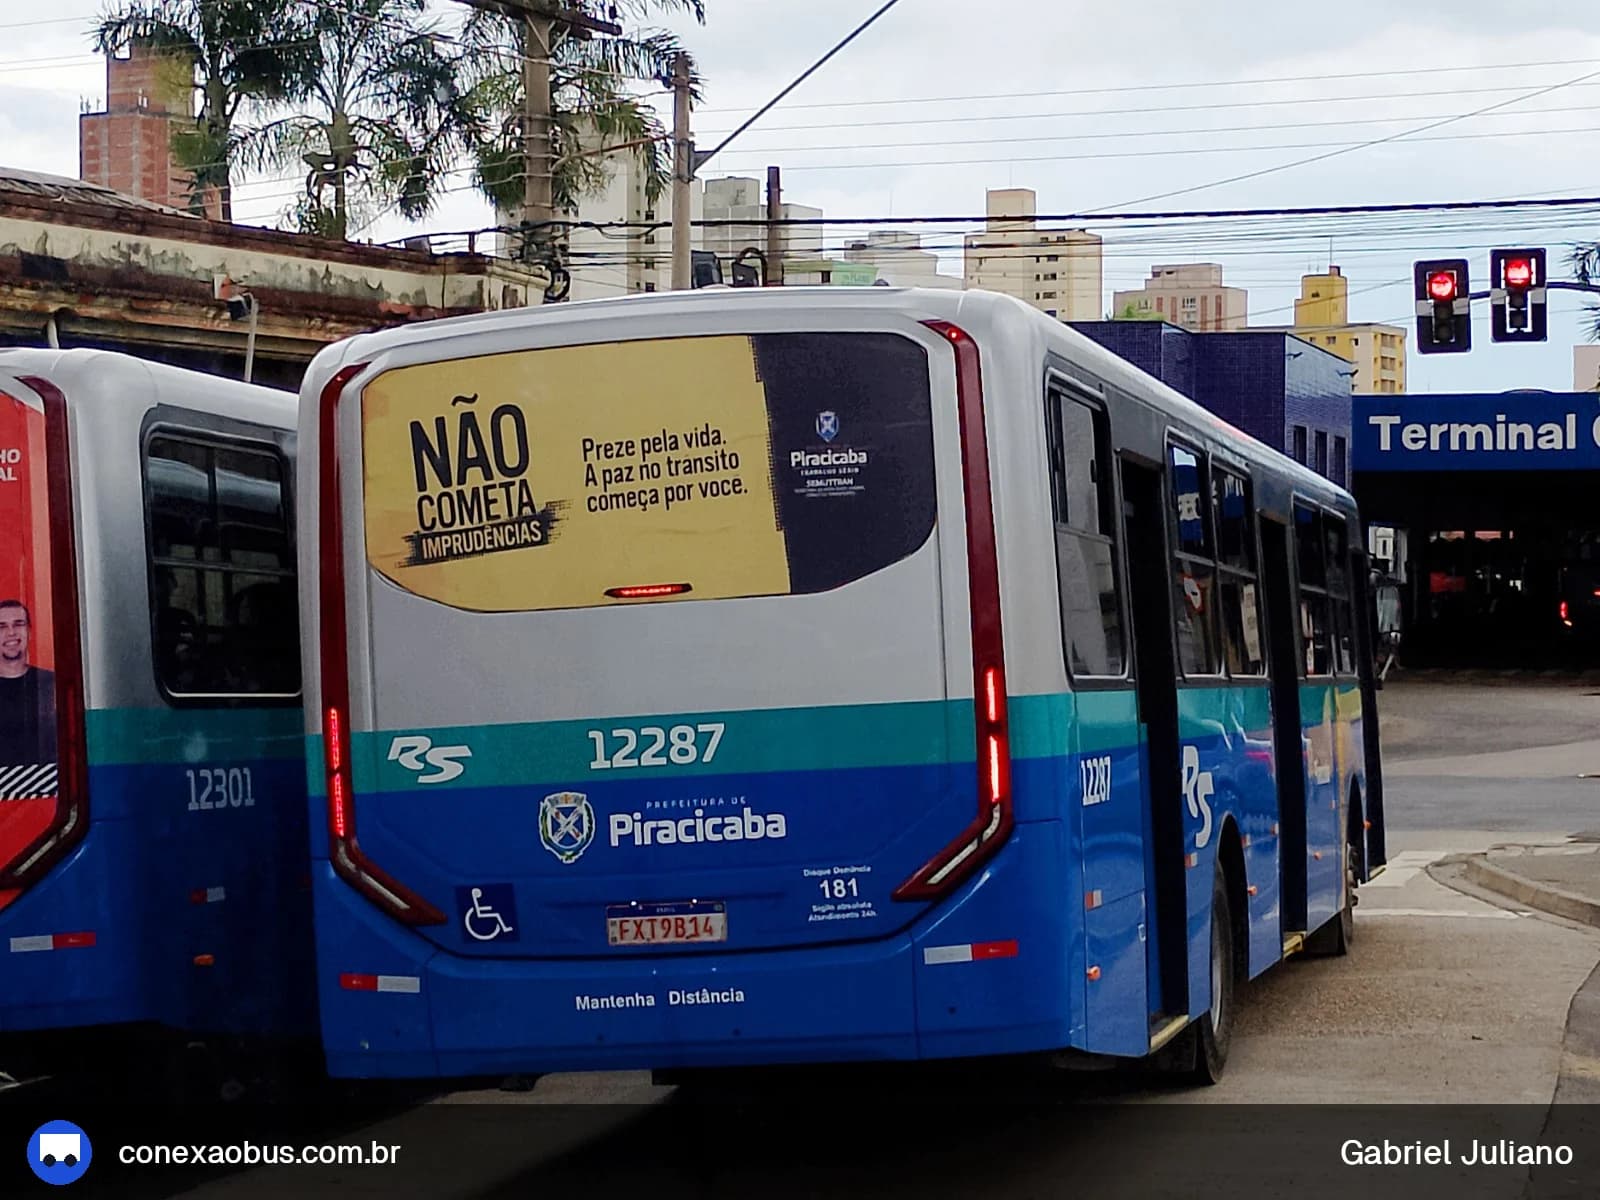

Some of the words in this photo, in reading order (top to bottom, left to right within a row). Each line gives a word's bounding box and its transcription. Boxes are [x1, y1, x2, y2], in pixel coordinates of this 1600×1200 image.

[410, 393, 530, 492] NÃO
[582, 438, 636, 462] Preze
[641, 429, 679, 461] pela
[684, 423, 727, 448] vida.
[1369, 414, 1577, 451] Terminal
[585, 463, 598, 487] A
[602, 466, 634, 492] paz
[640, 462, 661, 480] no
[790, 448, 867, 467] Piracicaba
[417, 479, 537, 531] COMETA
[587, 488, 659, 512] começa
[665, 484, 694, 510] por
[422, 519, 543, 560] IMPRUDÊNCIAS
[387, 736, 473, 783] RS
[588, 722, 726, 770] 12287
[186, 767, 255, 811] 12301
[1081, 755, 1111, 806] 12287
[646, 798, 725, 809] PREFEITURA
[609, 807, 786, 847] Piracicaba
[820, 878, 858, 898] 181
[619, 916, 713, 940] FXT9B14
[576, 993, 656, 1010] Mantenha
[669, 987, 745, 1005] Distância
